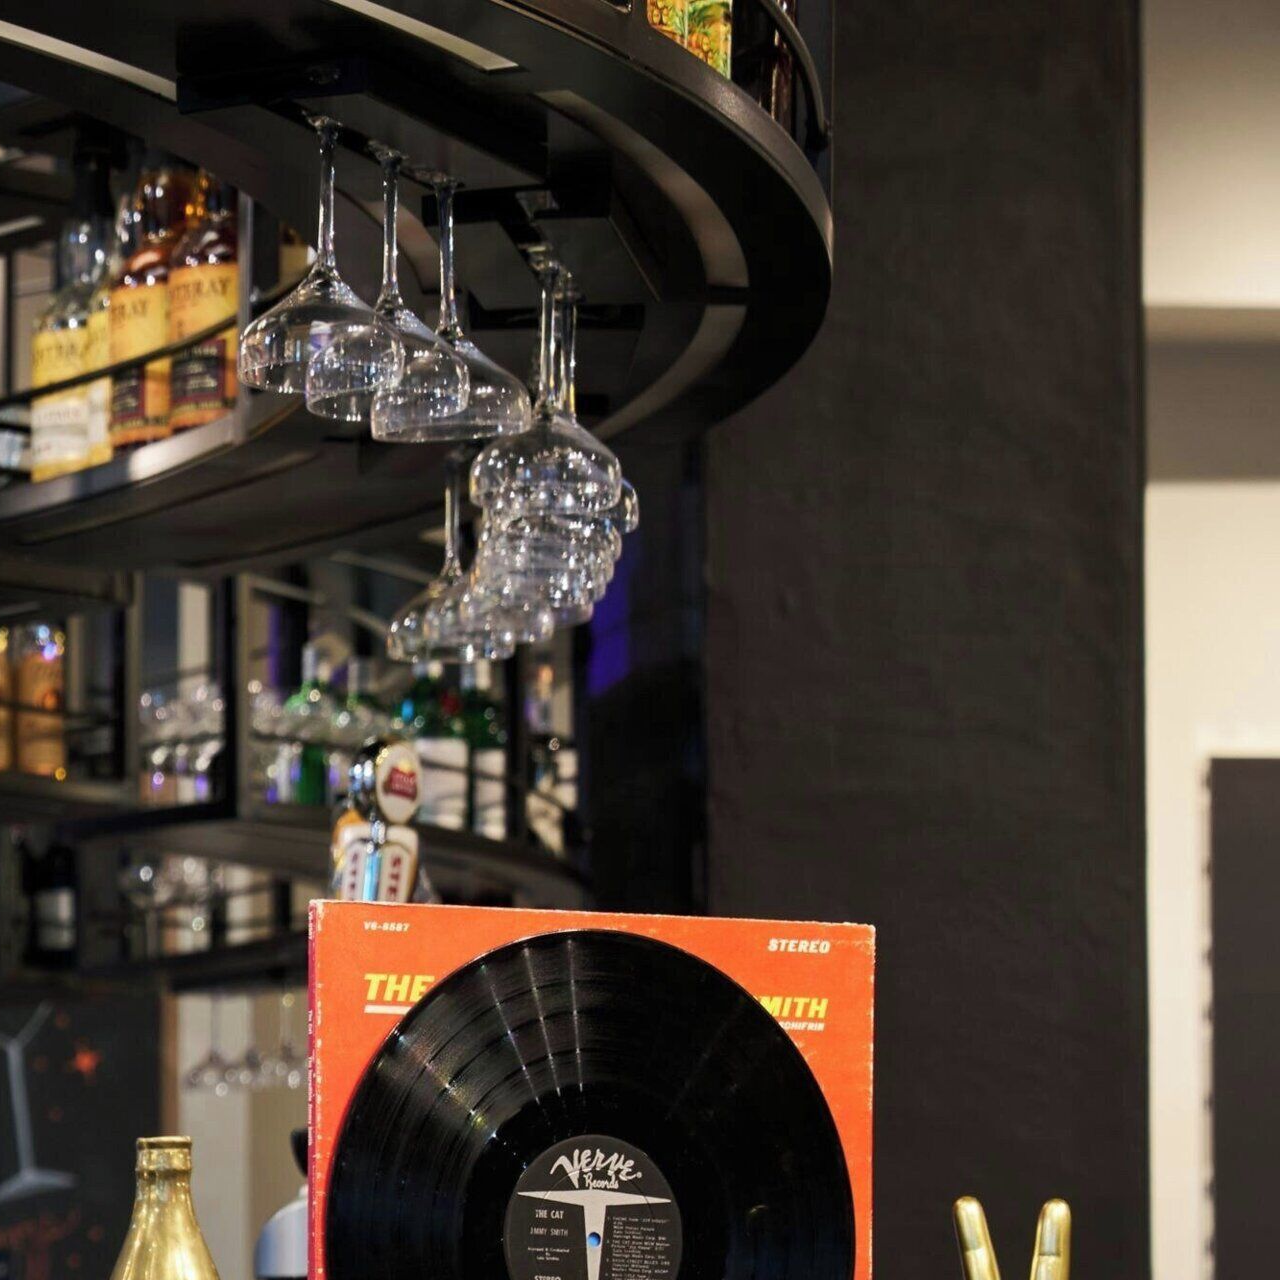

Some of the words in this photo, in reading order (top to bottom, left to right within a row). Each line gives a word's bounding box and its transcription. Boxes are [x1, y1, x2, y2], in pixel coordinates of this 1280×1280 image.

[363, 921, 411, 932] V6-8587
[767, 938, 831, 954] STEREO
[364, 973, 435, 1002] THE
[760, 996, 829, 1019] MITH
[550, 1148, 642, 1189] Verve
[583, 1173, 620, 1189] Records
[535, 1209, 548, 1219] THE
[550, 1210, 565, 1219] CAT
